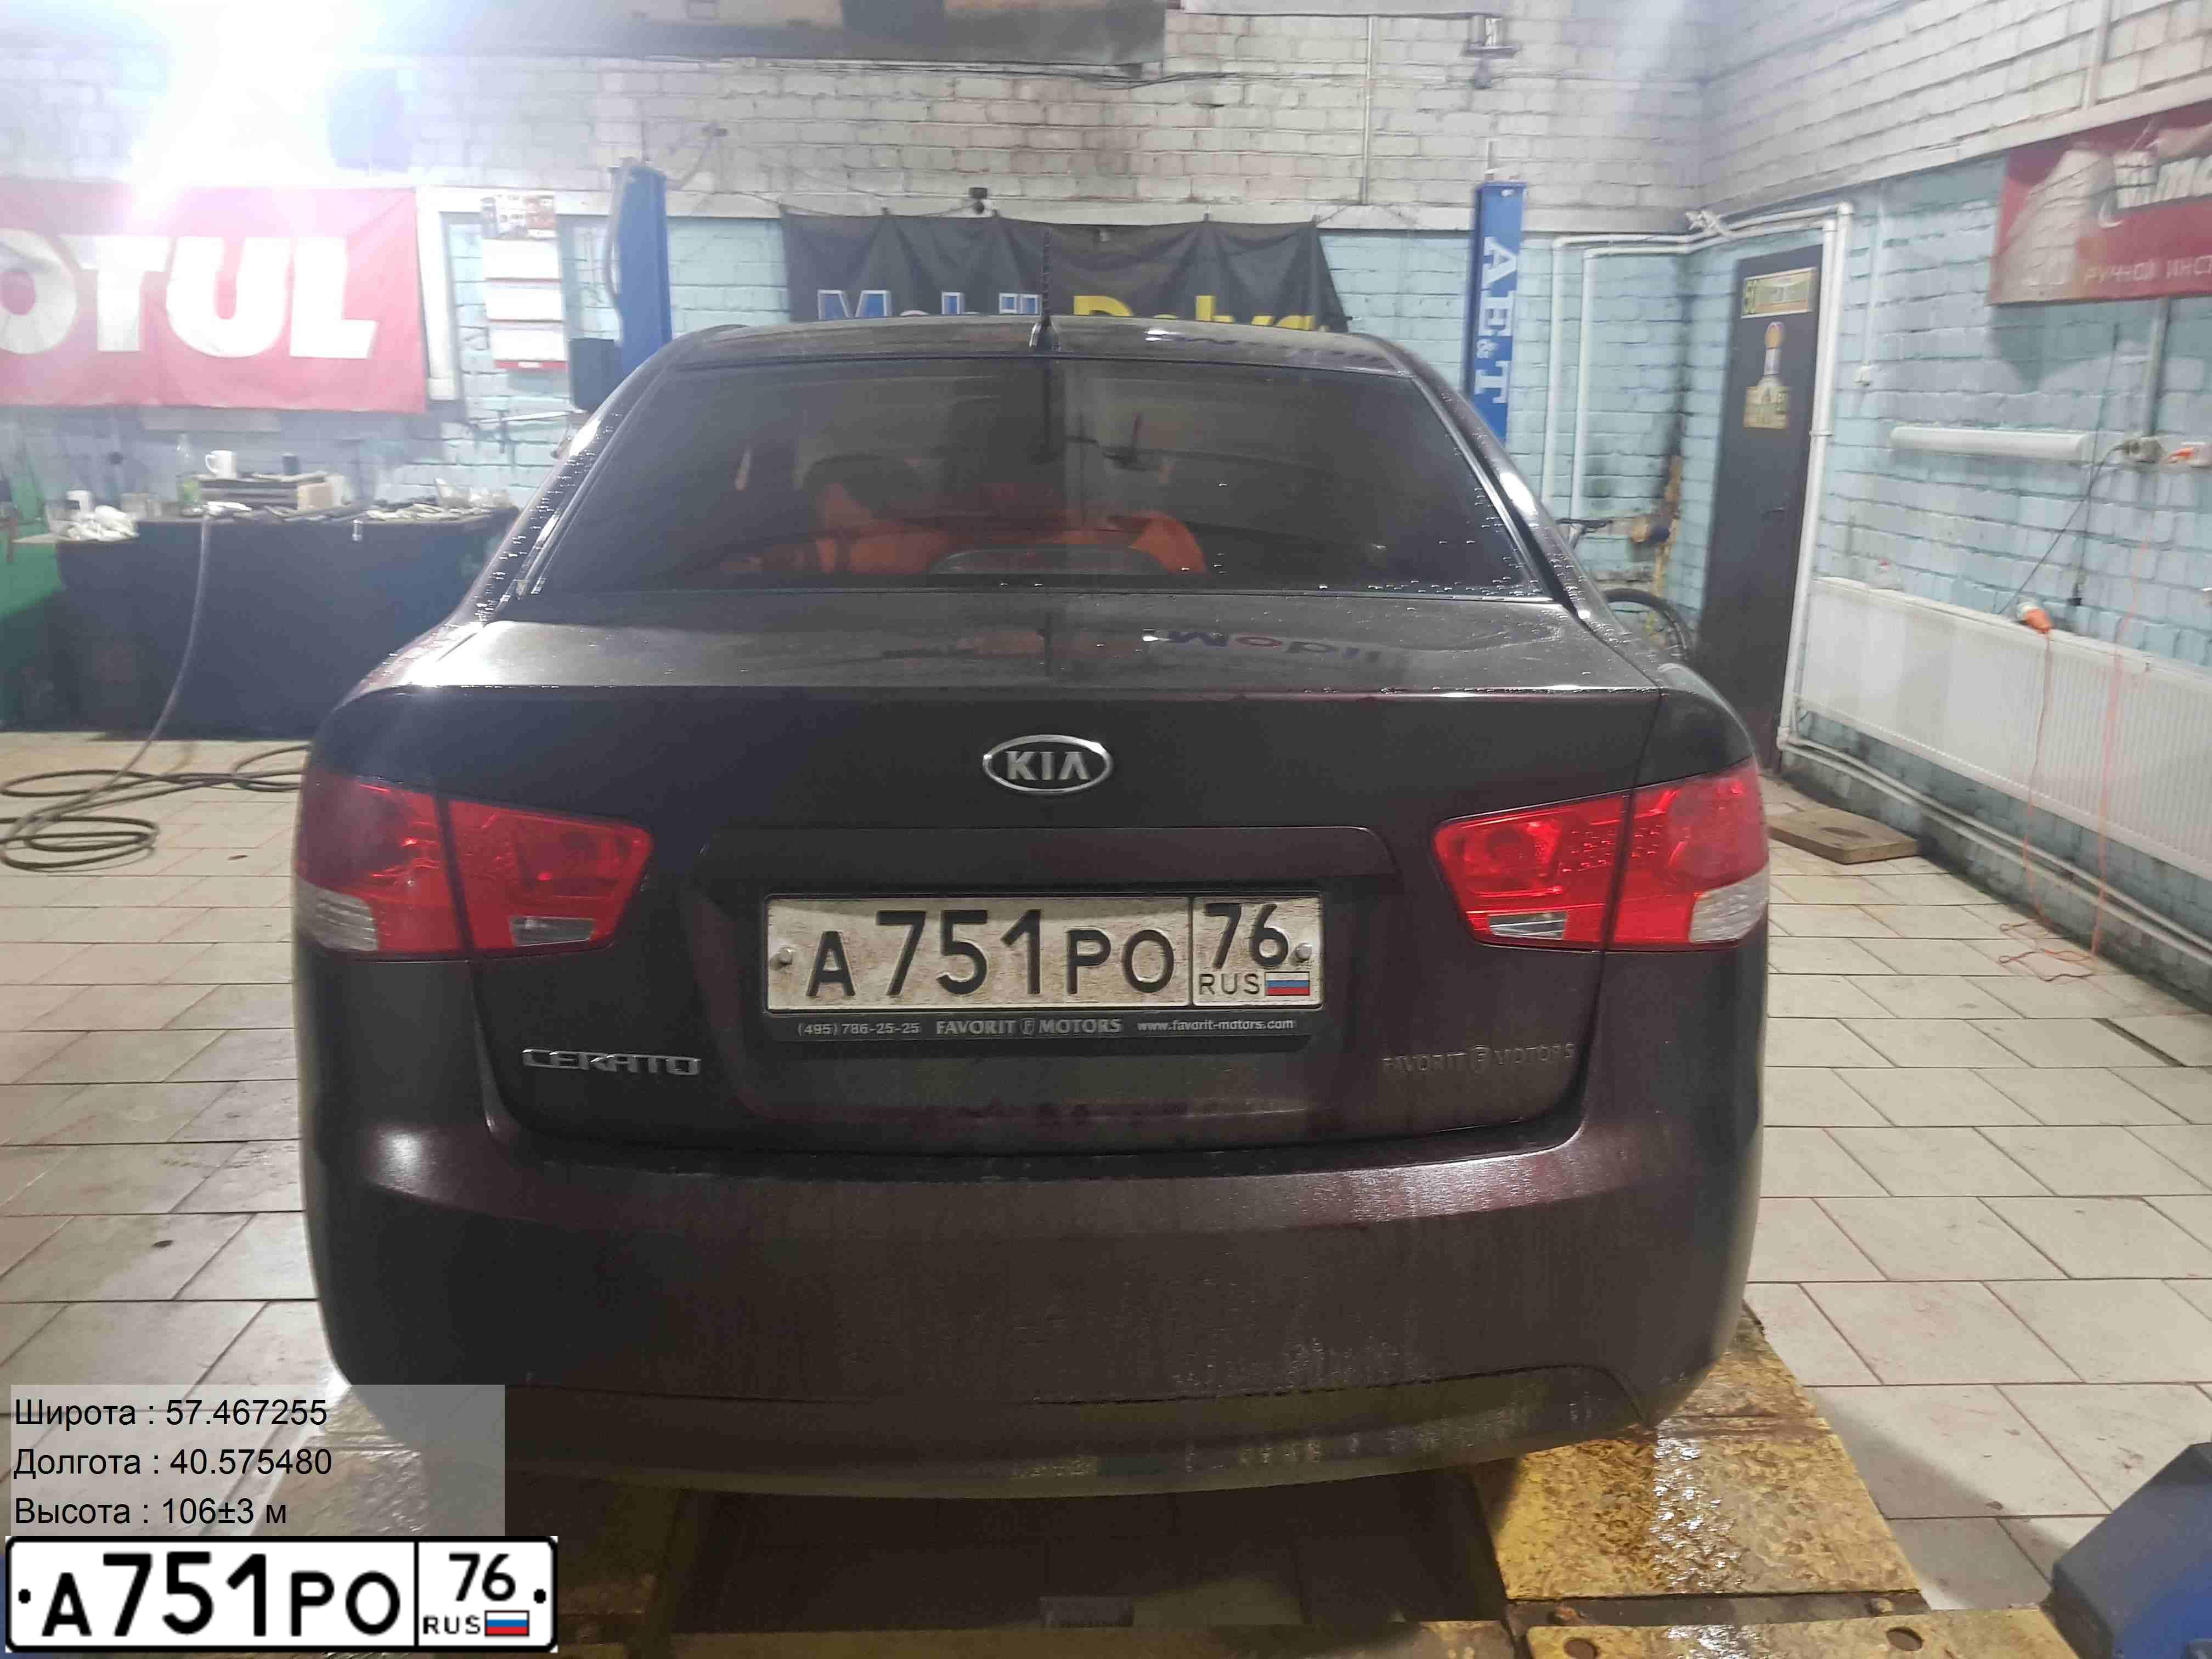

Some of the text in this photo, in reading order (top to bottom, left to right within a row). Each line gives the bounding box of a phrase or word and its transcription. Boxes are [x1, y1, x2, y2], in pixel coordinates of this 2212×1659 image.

[1005, 751, 1091, 781] KIA
[1202, 902, 1290, 970] 76
[1198, 972, 1261, 995] RUS
[797, 1022, 838, 1036] (495)
[842, 1022, 921, 1035] 786-25-25
[936, 1020, 1017, 1035] FAVORIT
[1039, 1018, 1122, 1034] MOTORS
[1137, 1019, 1296, 1031] www.favorit-motors.com
[522, 1048, 702, 1075] CERATO
